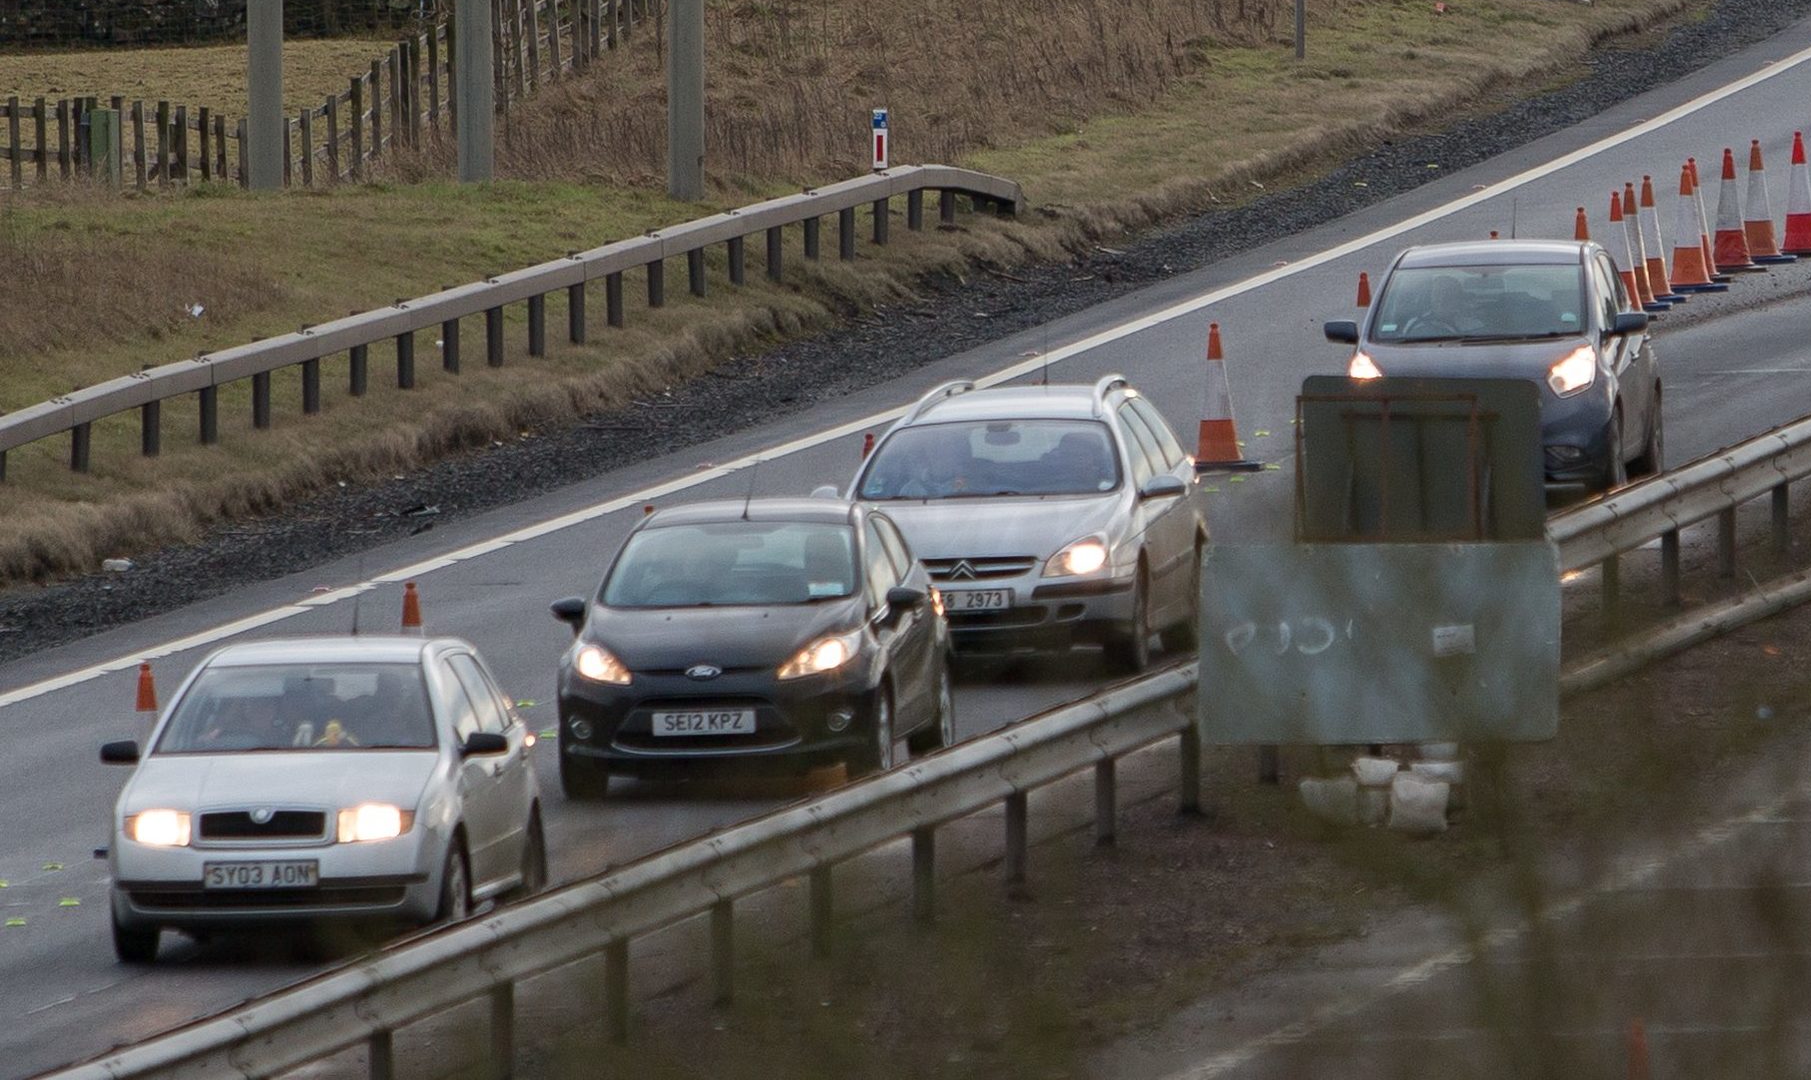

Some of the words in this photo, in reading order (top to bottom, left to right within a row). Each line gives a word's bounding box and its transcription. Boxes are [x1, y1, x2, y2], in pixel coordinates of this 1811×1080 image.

[966, 591, 1003, 609] 2973
[664, 713, 704, 732] SE12
[707, 712, 744, 730] KPZ
[212, 866, 263, 885] SY03
